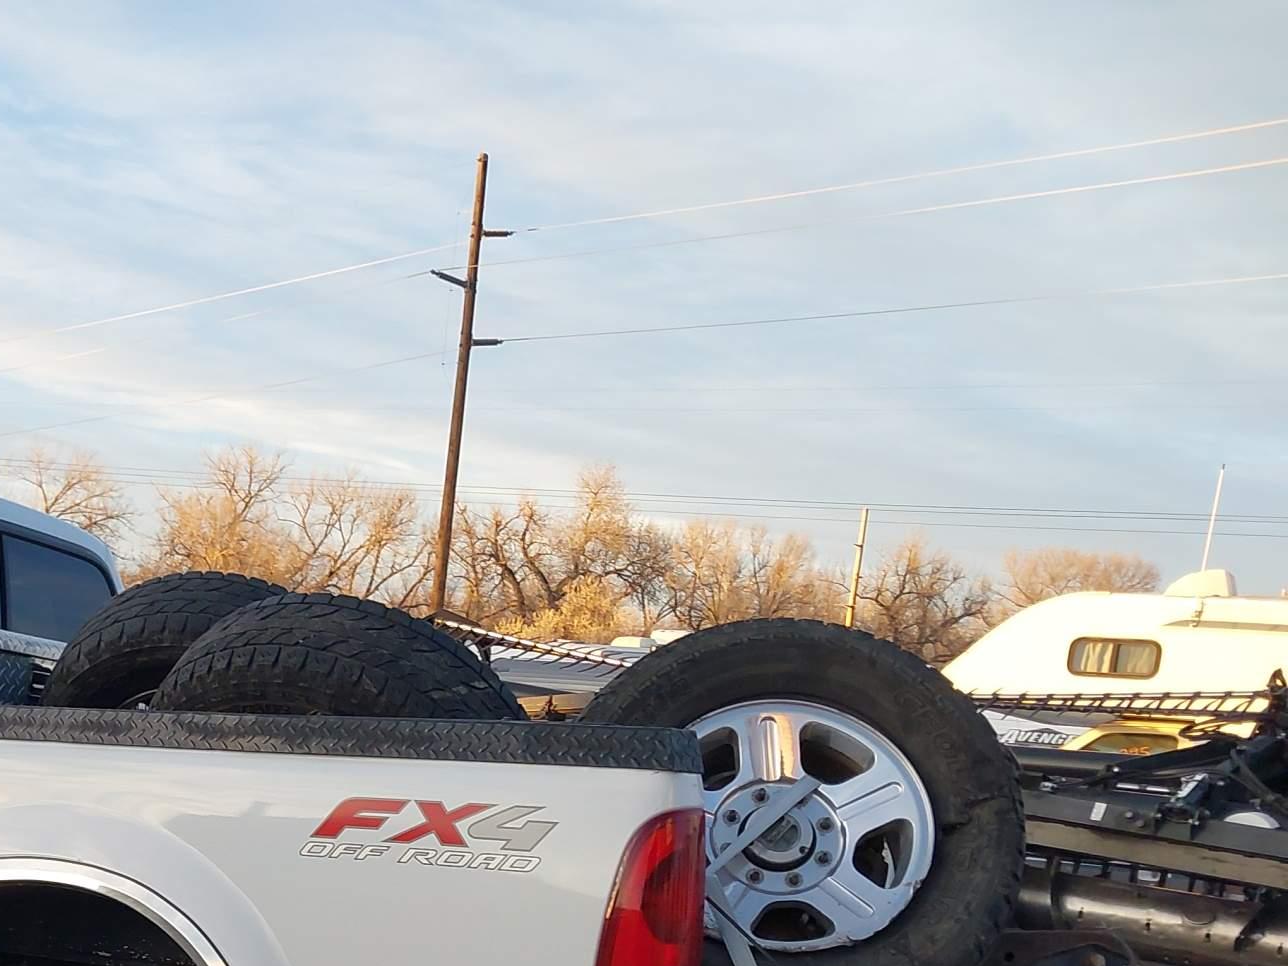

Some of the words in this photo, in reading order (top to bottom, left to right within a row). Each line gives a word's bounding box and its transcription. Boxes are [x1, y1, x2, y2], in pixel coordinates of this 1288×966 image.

[310, 796, 560, 852] FX4
[299, 841, 391, 861] OFF
[396, 847, 542, 873] ROAD
